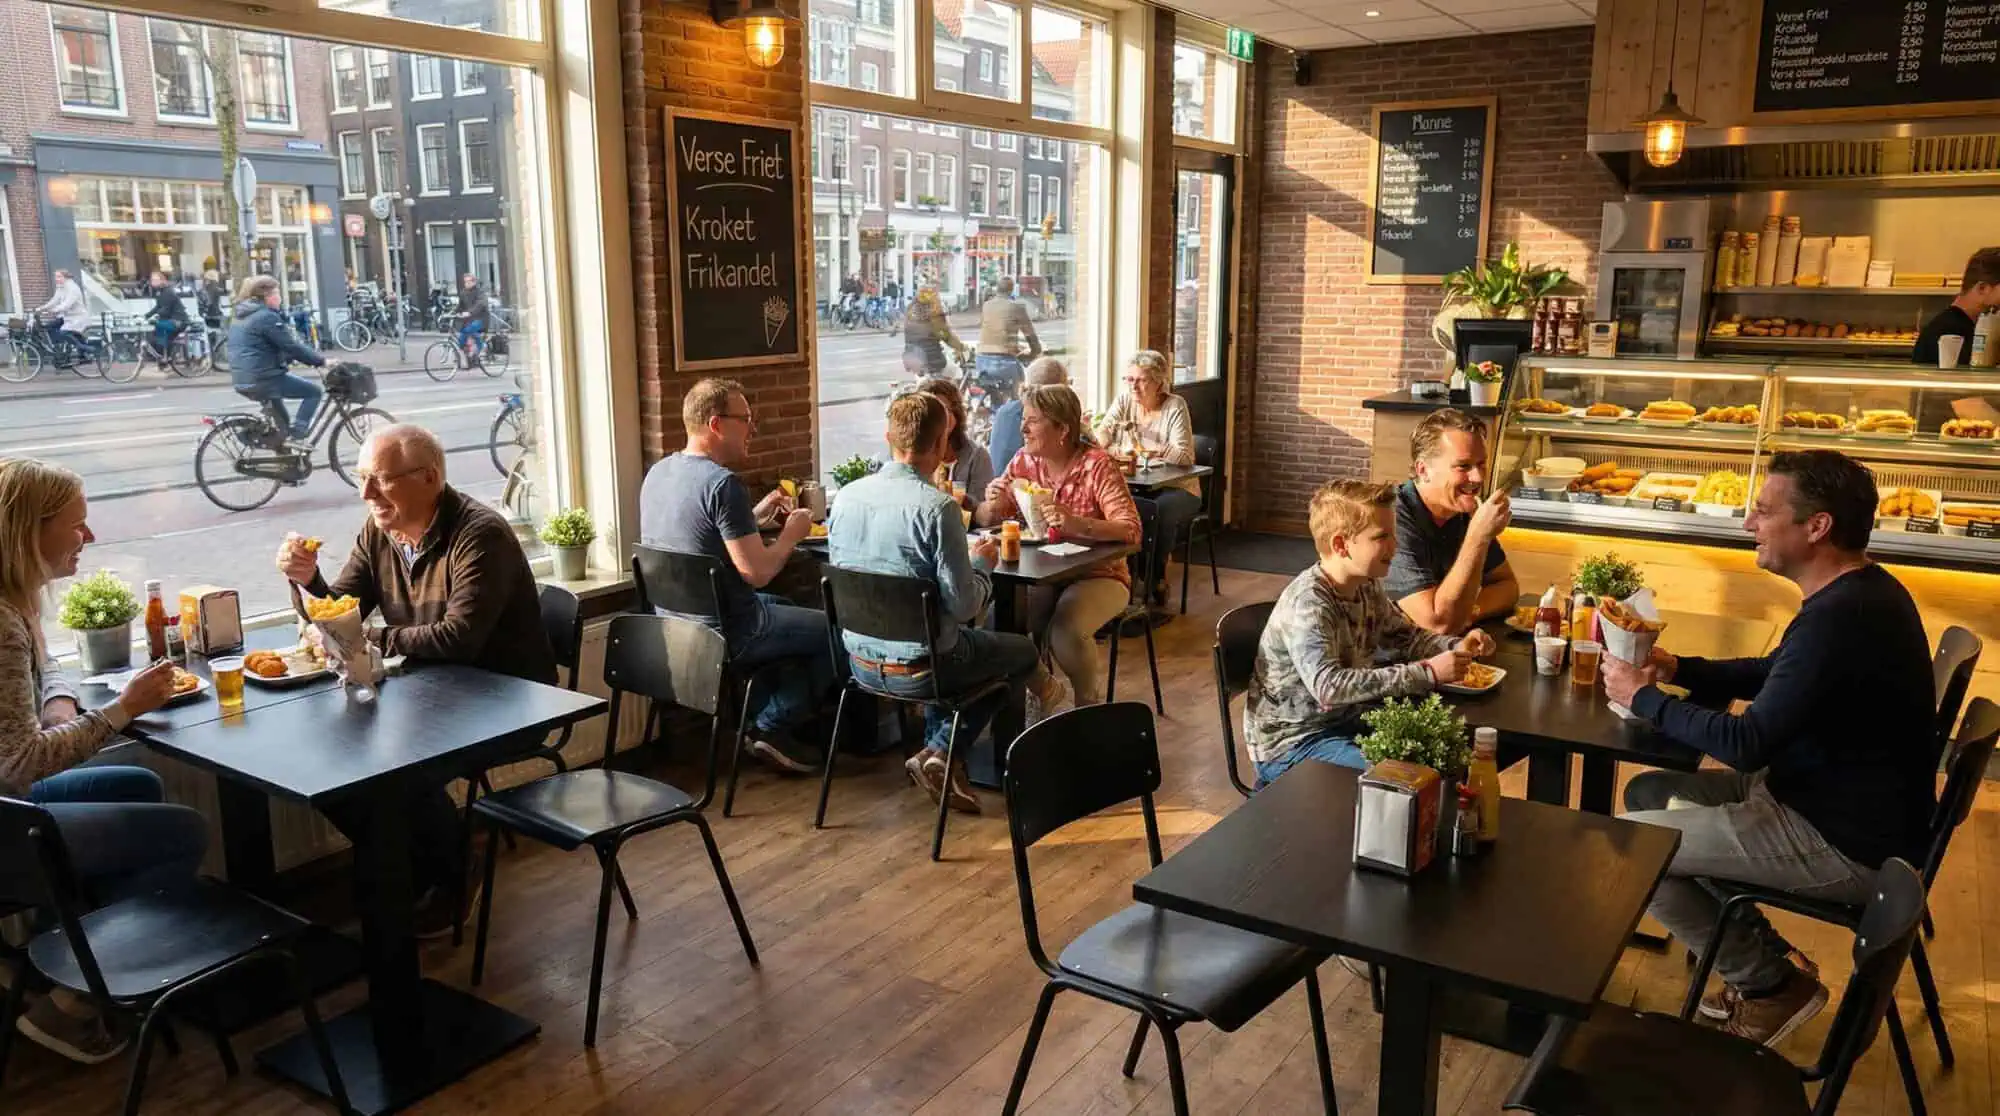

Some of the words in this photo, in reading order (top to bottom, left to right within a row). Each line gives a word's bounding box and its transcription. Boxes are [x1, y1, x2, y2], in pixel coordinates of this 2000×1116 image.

[680, 135, 736, 175] Verse
[741, 138, 785, 180] Friet
[685, 204, 757, 241] Kroket
[687, 252, 778, 289] Frikandel
